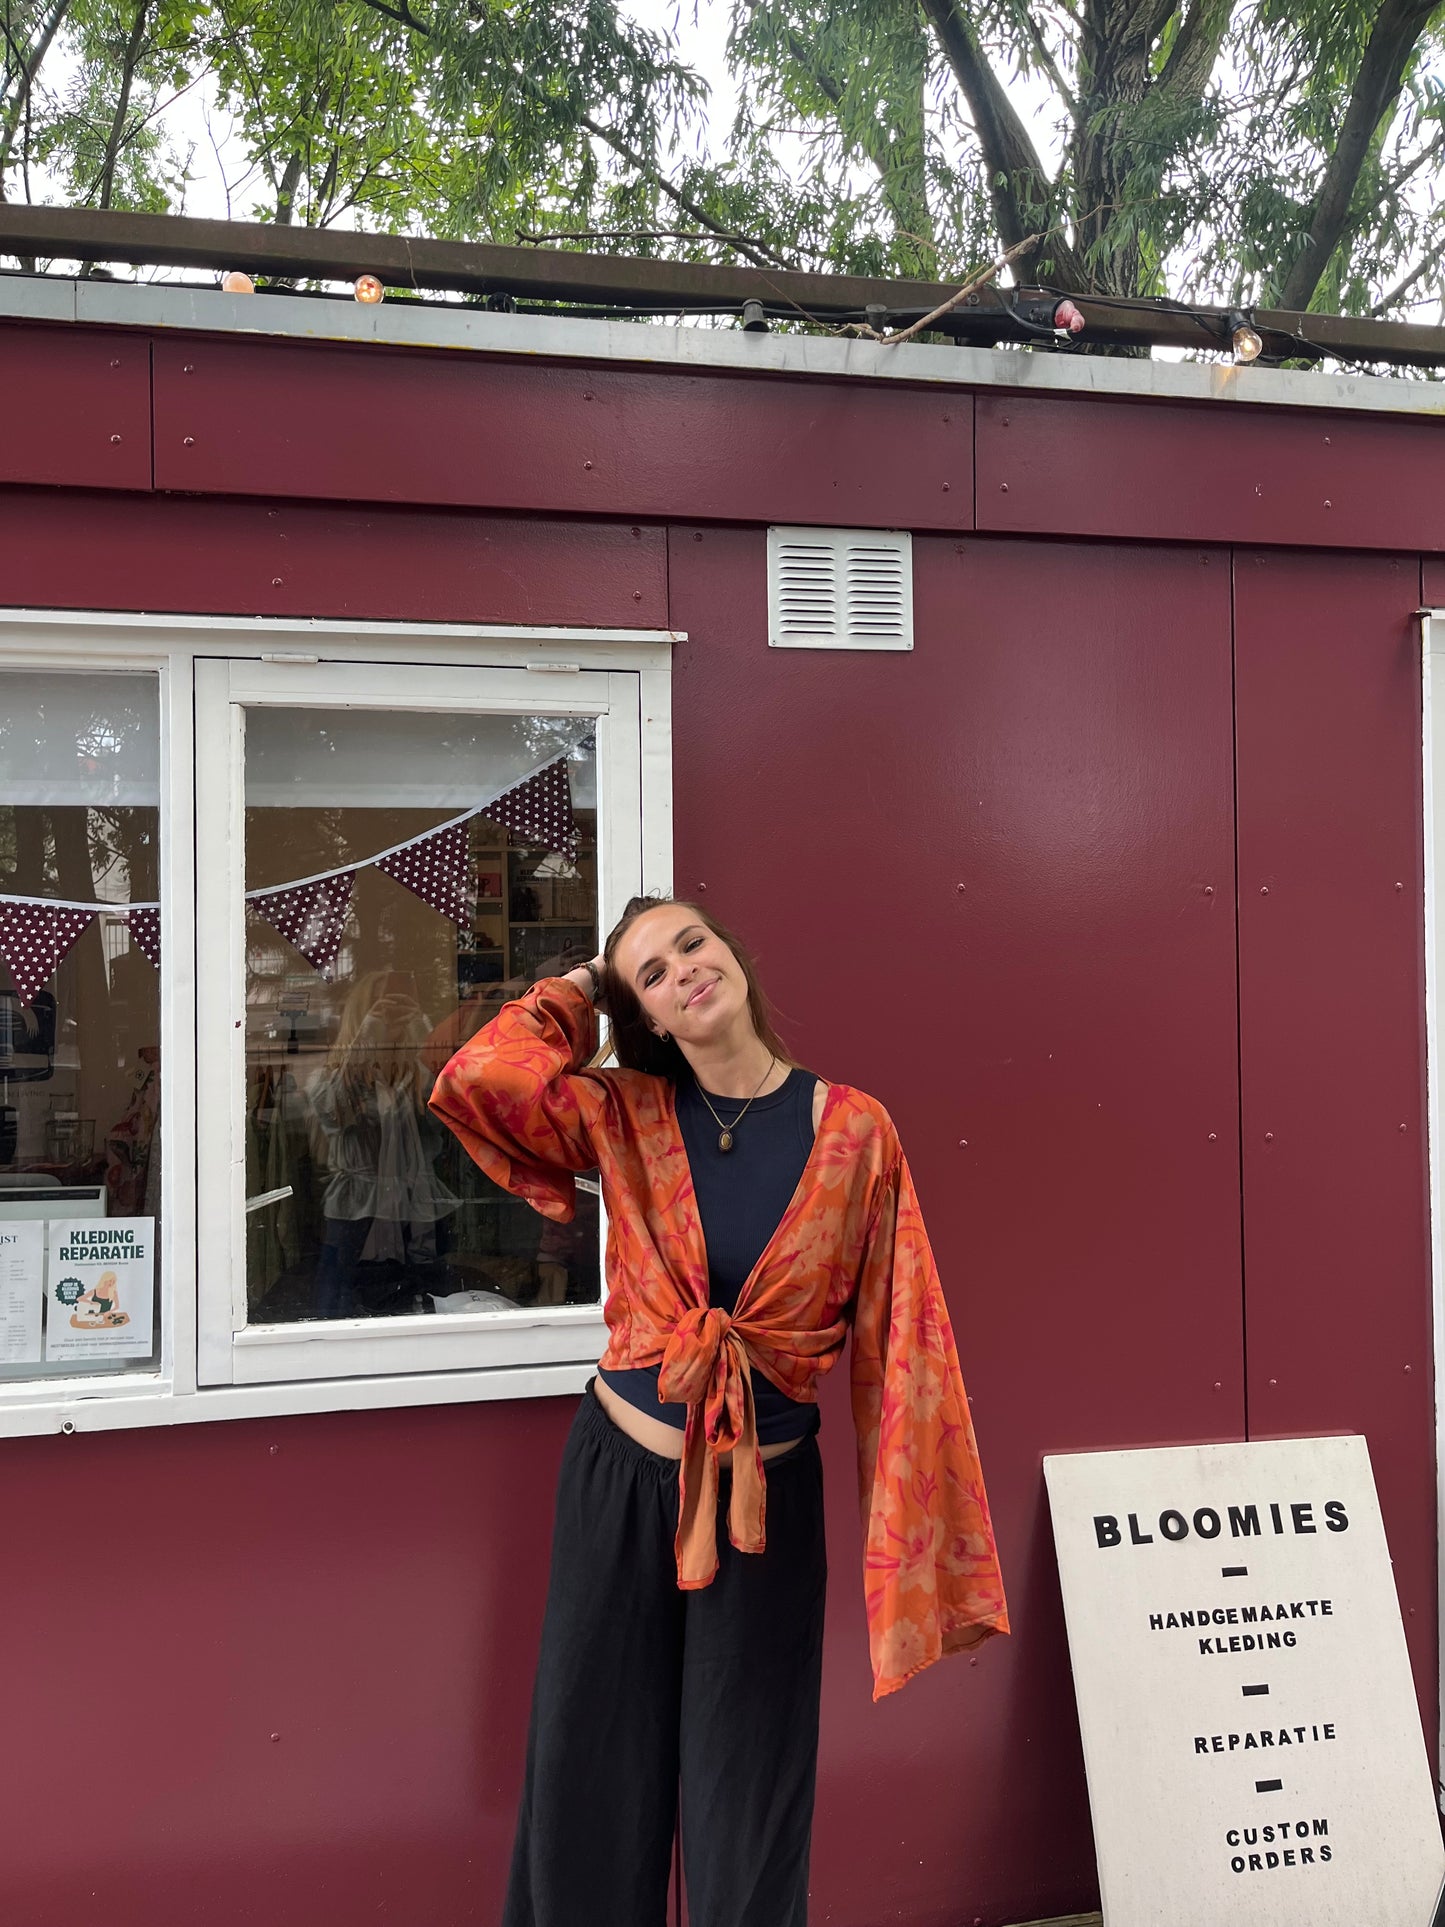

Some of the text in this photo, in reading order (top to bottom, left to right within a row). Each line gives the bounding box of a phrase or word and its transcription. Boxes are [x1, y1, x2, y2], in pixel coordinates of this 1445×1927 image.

[70, 1229, 134, 1245] KLEDING
[59, 1245, 145, 1261] REPARATIE
[1094, 1501, 1349, 1548] BLOOMIES
[1150, 1600, 1333, 1630] HANDGEMAAKTE
[1199, 1631, 1297, 1655] KLEDING
[1194, 1724, 1336, 1754] REPARATIE
[1226, 1819, 1329, 1847] CUSTOM
[1231, 1845, 1332, 1873] ORDERS
